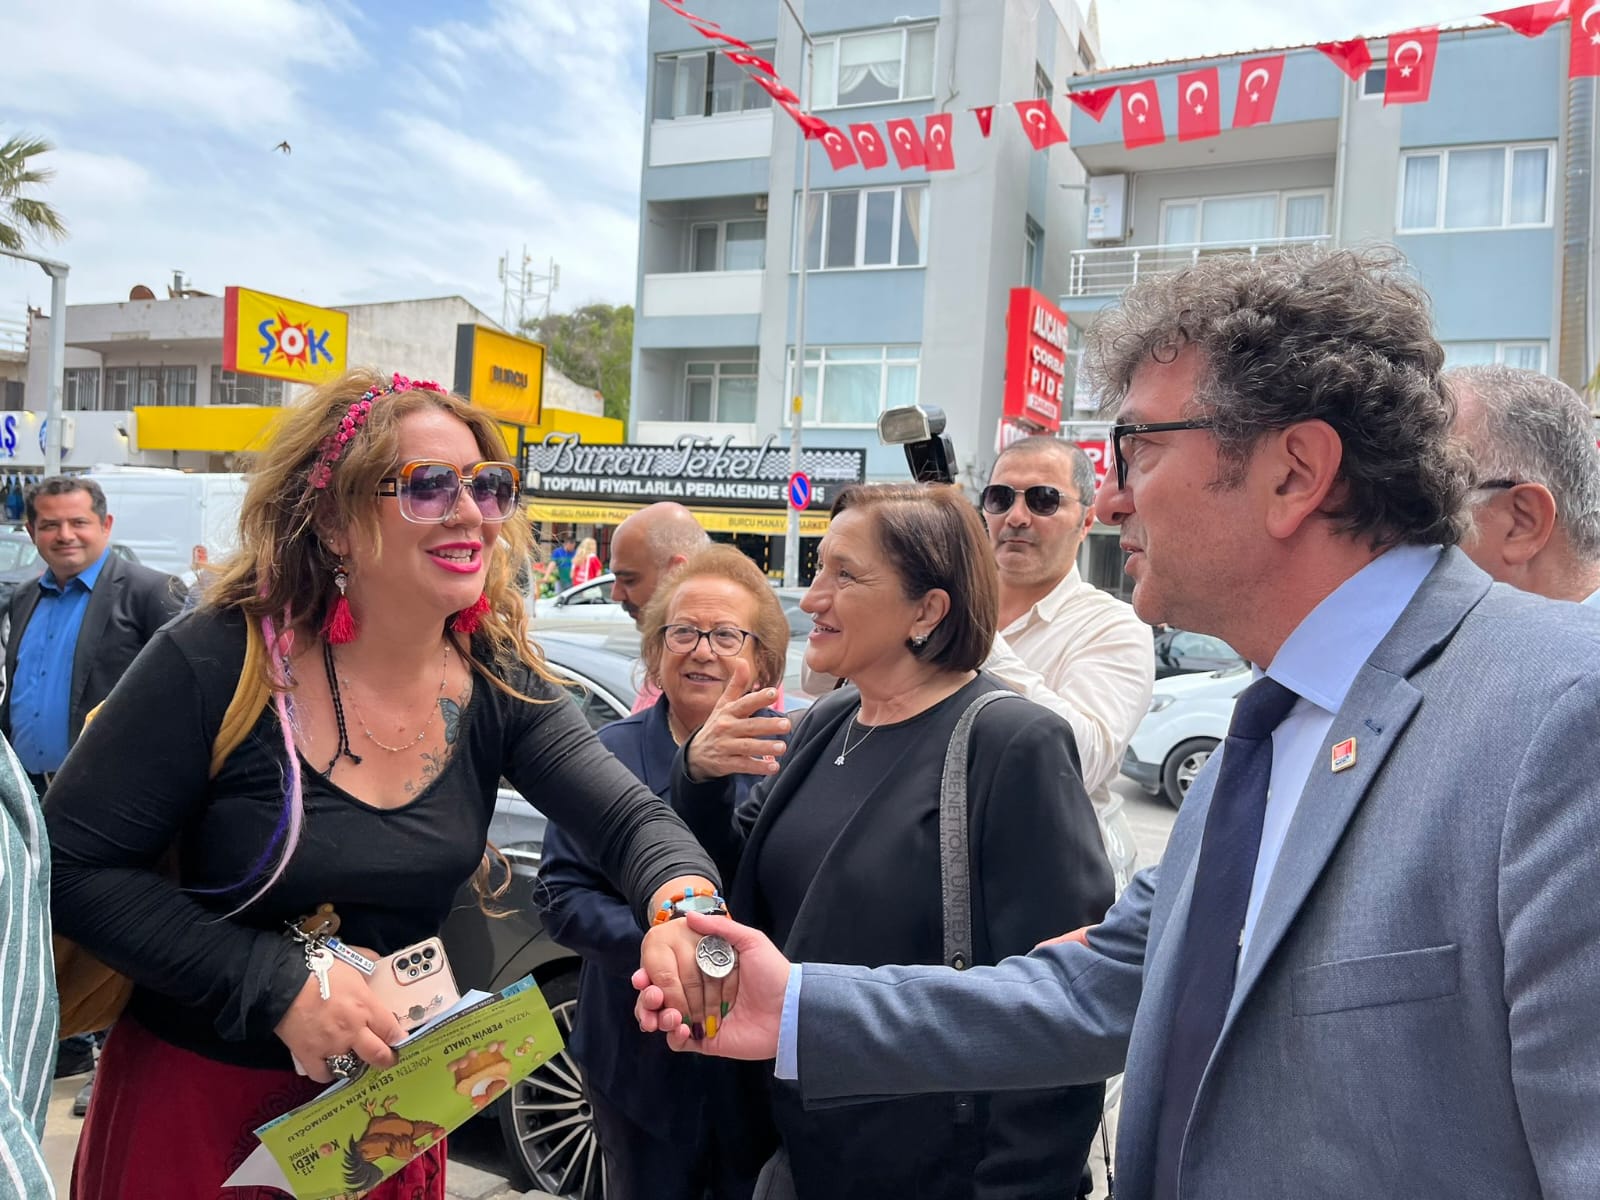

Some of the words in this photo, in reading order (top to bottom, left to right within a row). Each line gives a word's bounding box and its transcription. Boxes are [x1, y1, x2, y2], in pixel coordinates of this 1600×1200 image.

[258, 318, 334, 365] ŞOK
[0, 415, 17, 458] Ş
[535, 431, 655, 475] Burcu
[663, 433, 778, 480] Tekel
[541, 476, 598, 492] TOPTAN
[599, 477, 684, 496] FİYATLARLA
[685, 482, 779, 500] PERAKENDE
[781, 486, 825, 503] SIŞ
[728, 517, 756, 527] BURCU
[757, 518, 786, 528] MANAV
[950, 875, 968, 943] UNITED
[505, 1010, 530, 1025] YAZAN
[472, 1022, 503, 1041] PERVİN
[443, 1037, 472, 1056] ÜNALP
[396, 1055, 433, 1078] YÖNETEN
[369, 1073, 394, 1092] SELİN
[346, 1088, 367, 1106] AKIN
[287, 1104, 347, 1143] YARDIMOĞLU
